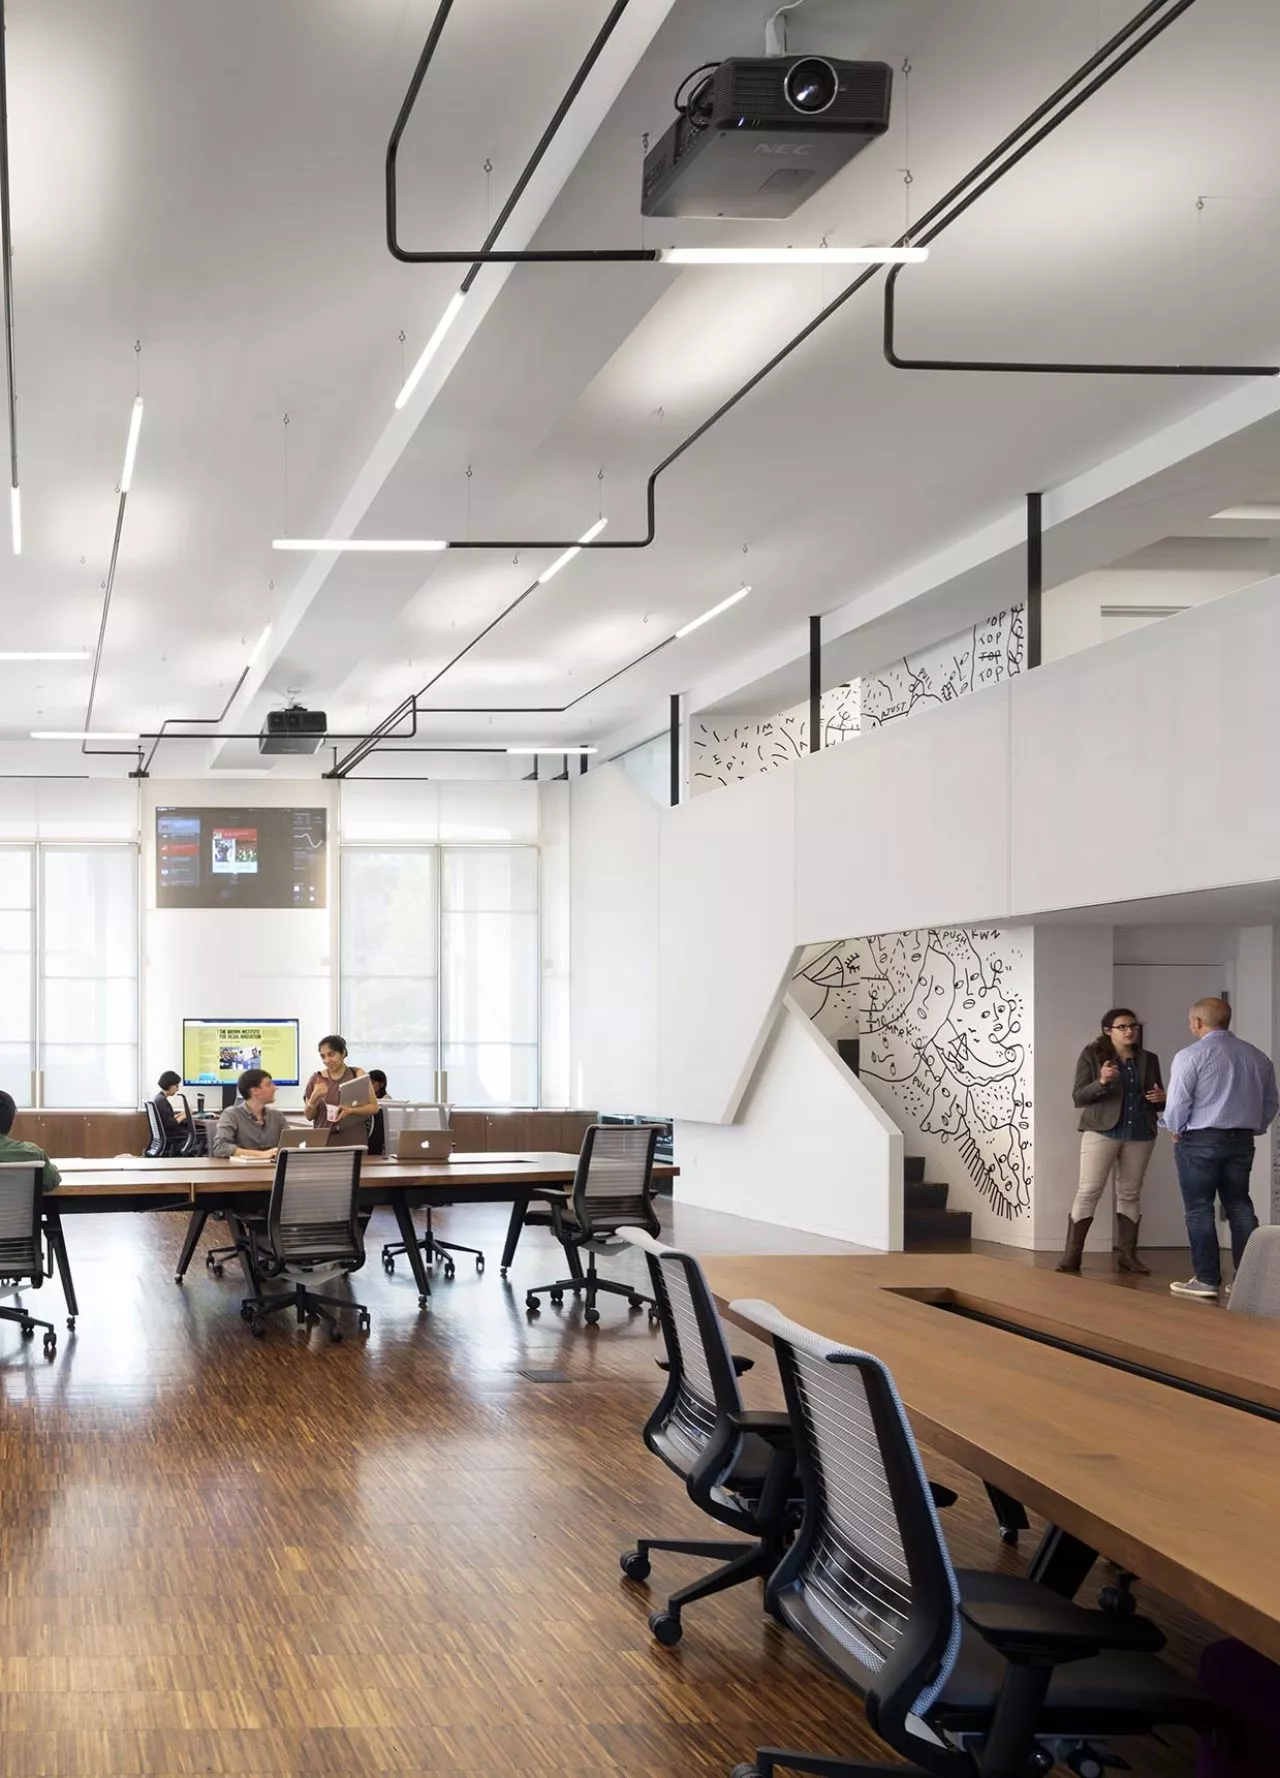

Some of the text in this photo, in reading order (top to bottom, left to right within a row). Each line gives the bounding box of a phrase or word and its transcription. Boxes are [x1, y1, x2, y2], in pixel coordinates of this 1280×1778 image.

[753, 143, 813, 155] NEC
[979, 631, 1001, 645] TOP
[979, 666, 1003, 682] TOP
[942, 931, 967, 945] PUSH
[912, 1076, 931, 1096] PULL
